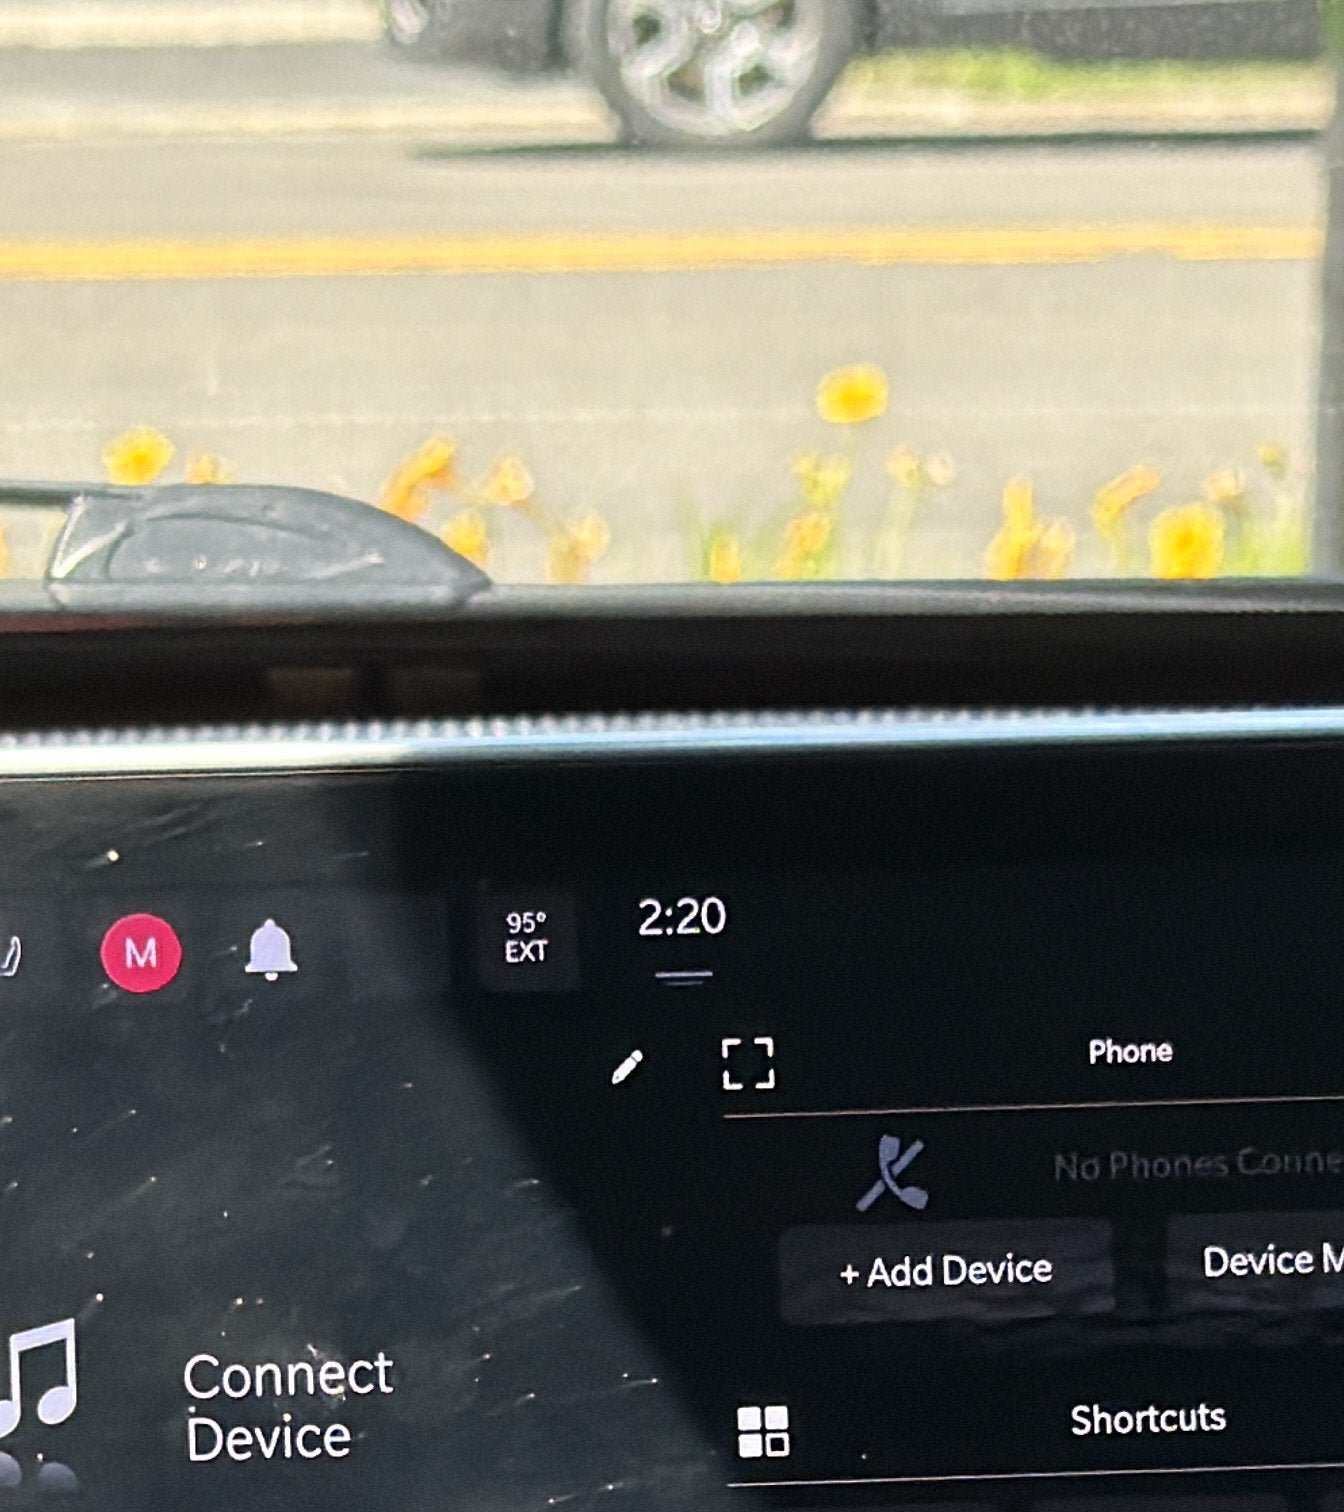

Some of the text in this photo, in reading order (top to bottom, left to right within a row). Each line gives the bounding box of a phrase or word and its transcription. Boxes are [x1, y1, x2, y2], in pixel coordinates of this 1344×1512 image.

[506, 912, 546, 933] 95°
[639, 897, 726, 935] 2:20
[125, 938, 156, 968] M
[506, 940, 548, 962] EXT
[1090, 1039, 1173, 1064] Phone
[1055, 1153, 1100, 1180] No
[1111, 1151, 1228, 1178] Phones
[867, 1256, 932, 1287] Add
[943, 1253, 1052, 1285] Device
[1204, 1244, 1314, 1277] Device
[184, 1352, 393, 1399] Connect
[1072, 1404, 1226, 1435] Shortcuts
[188, 1413, 351, 1461] Device
